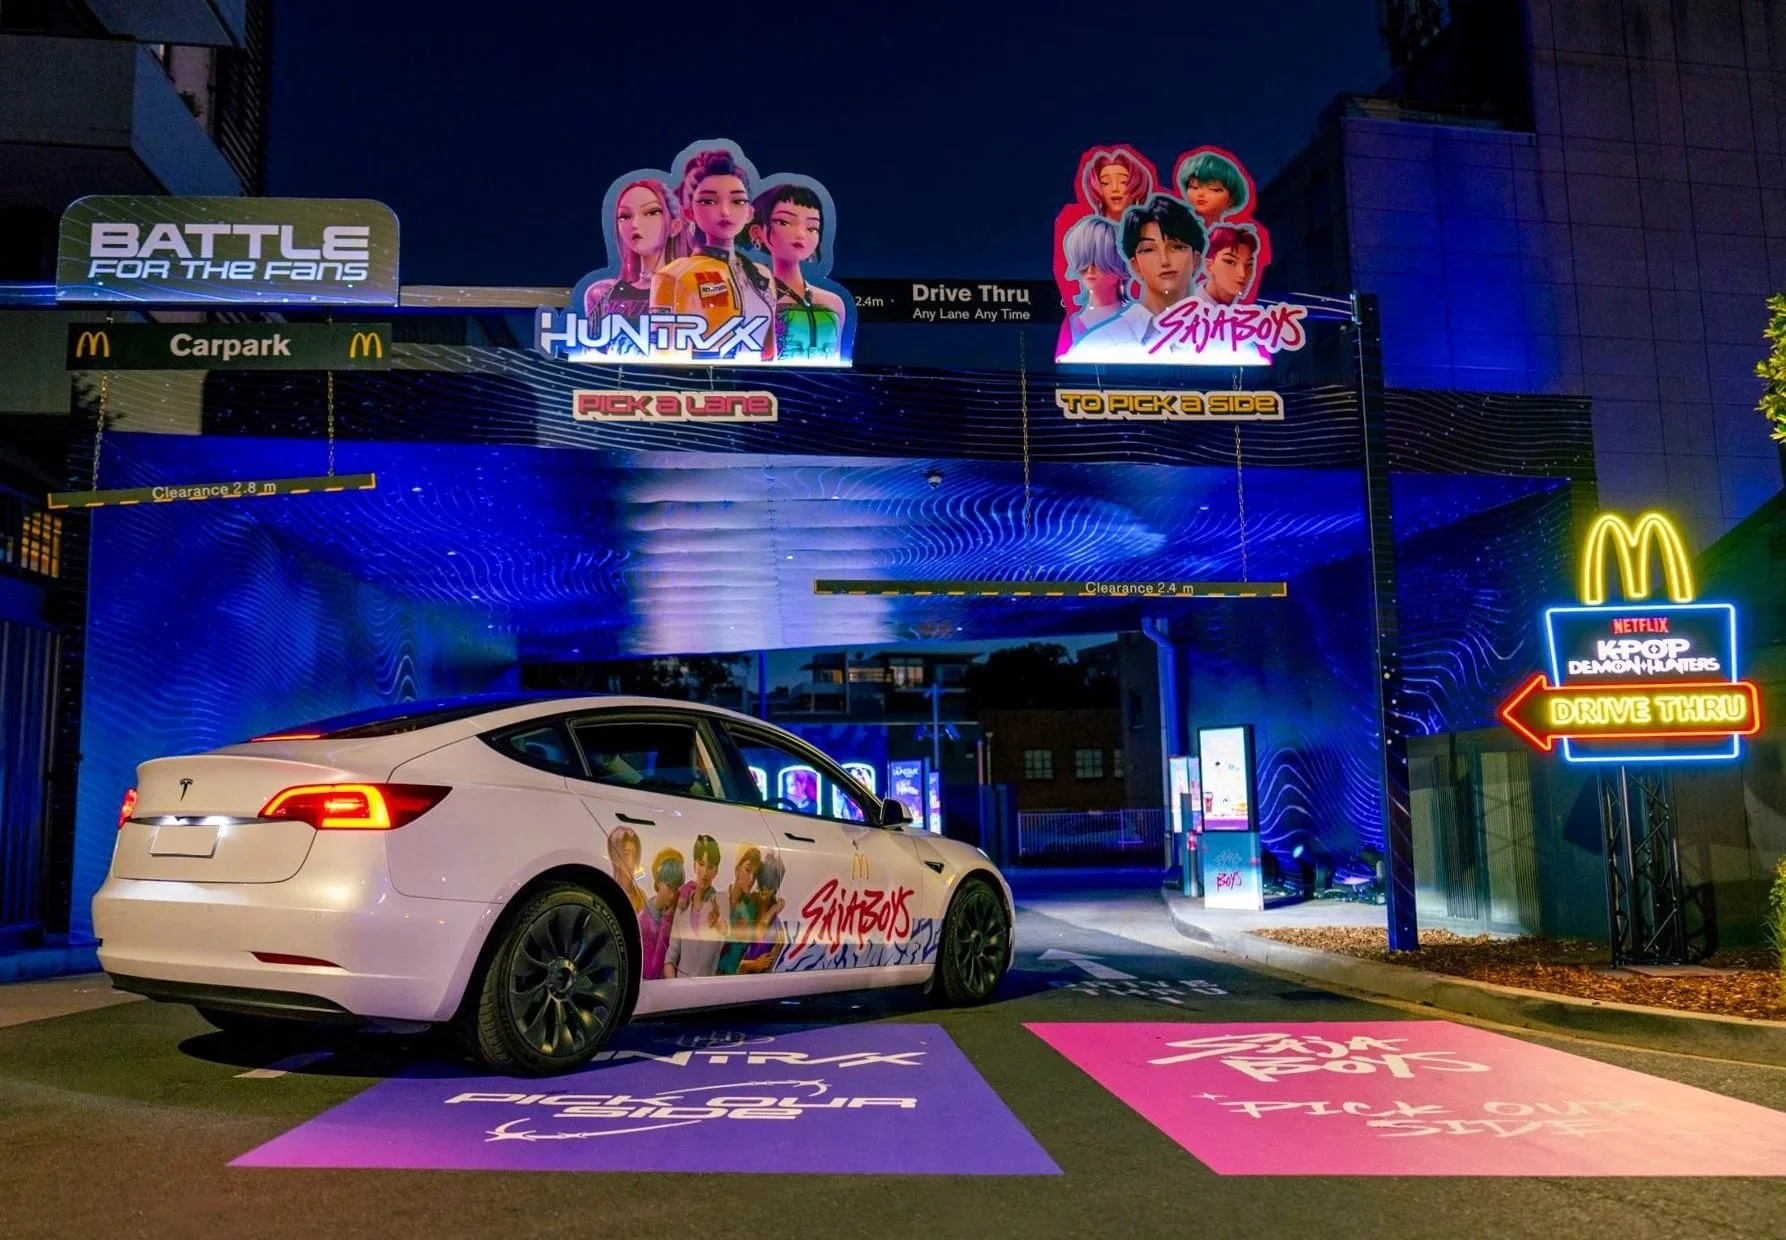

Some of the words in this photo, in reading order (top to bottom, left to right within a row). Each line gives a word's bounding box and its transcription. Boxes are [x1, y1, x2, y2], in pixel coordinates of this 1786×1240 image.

[90, 222, 370, 260] BATTLE
[88, 259, 170, 279] FOR
[855, 296, 884, 307] 2.4m
[912, 284, 972, 302] Drive
[978, 285, 1030, 303] Thru
[912, 308, 936, 322] Any
[940, 308, 969, 319] Lane
[974, 308, 998, 322] Any
[1000, 308, 1031, 320] Time
[169, 333, 291, 361] Carpark
[578, 394, 650, 415] PICK
[1060, 393, 1103, 414] TO
[1108, 394, 1177, 415] PICK
[152, 485, 229, 499] Clearance
[233, 481, 257, 494] 2.8
[263, 482, 277, 493] m
[1085, 581, 1153, 594] Clearance
[1157, 582, 1176, 594] 2.4
[1183, 585, 1194, 594] m
[1613, 617, 1669, 634] NETFLIX
[1568, 656, 1642, 675] DEMON
[1647, 658, 1720, 675] HUNTERS
[1551, 696, 1651, 725] DRIVE
[1655, 694, 1746, 723] THRU
[1220, 1051, 1492, 1082] BOYS
[444, 1093, 684, 1106] PICK
[706, 1096, 917, 1109] OUR
[1218, 1099, 1454, 1119] PICK
